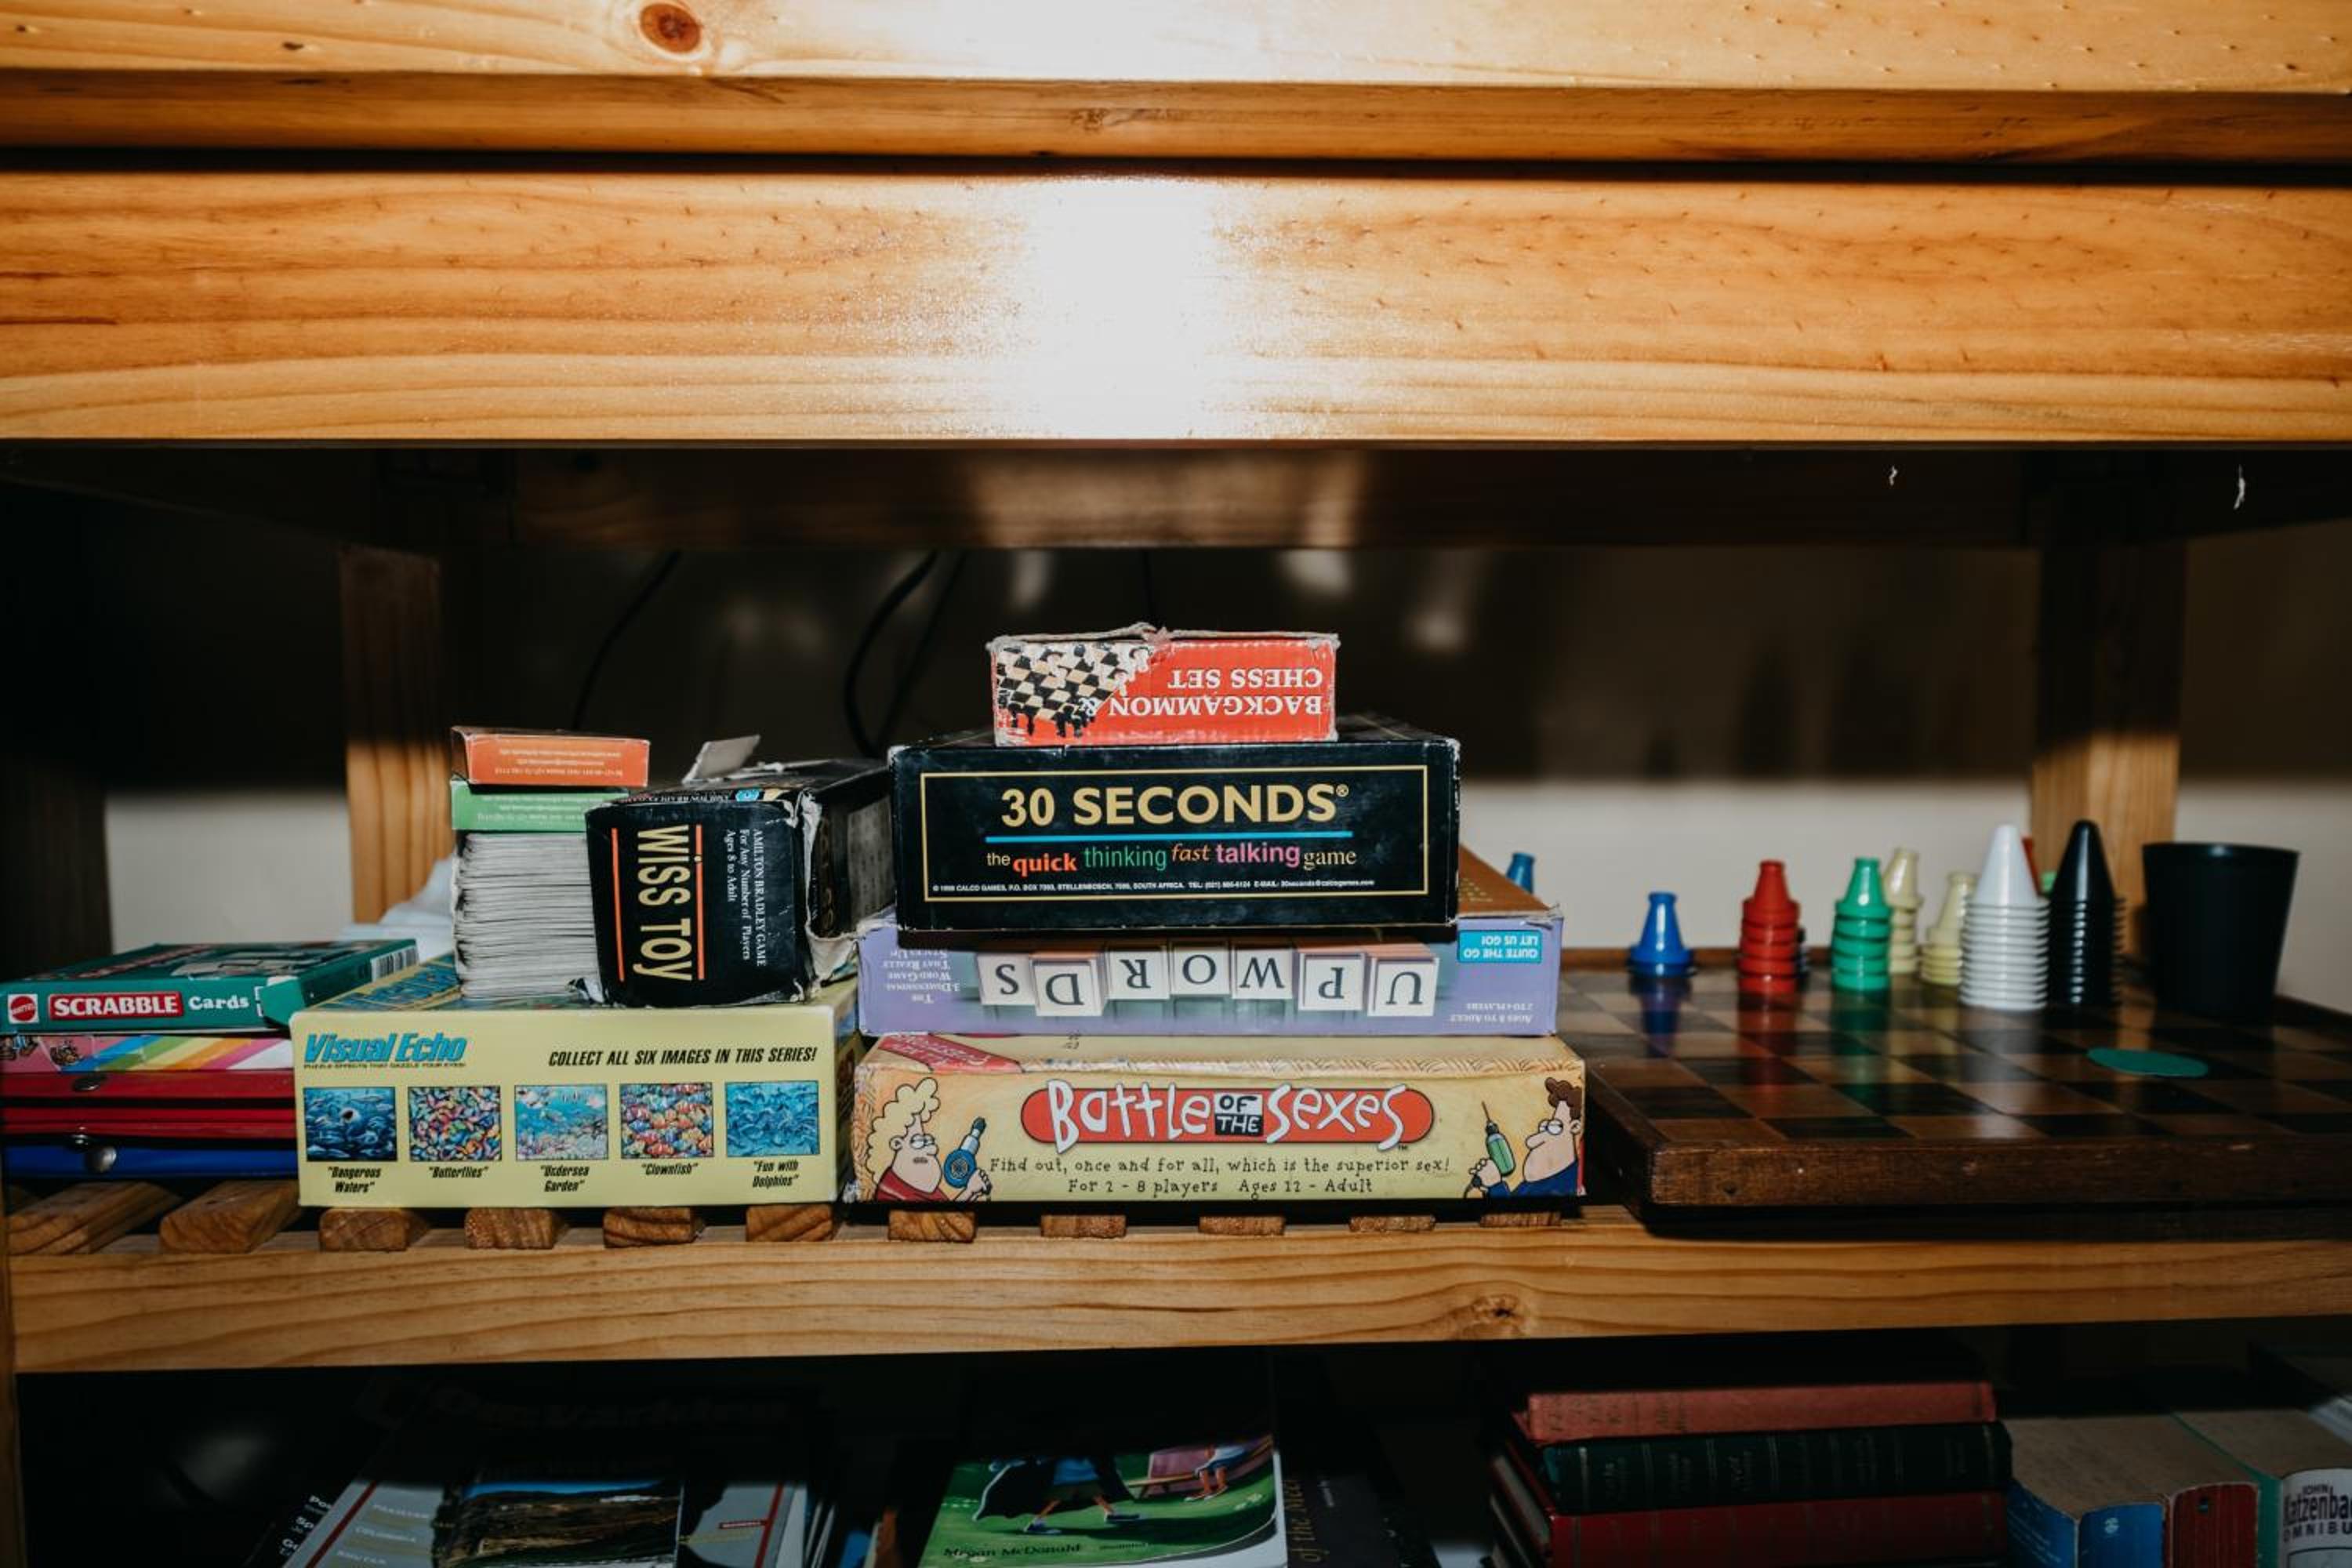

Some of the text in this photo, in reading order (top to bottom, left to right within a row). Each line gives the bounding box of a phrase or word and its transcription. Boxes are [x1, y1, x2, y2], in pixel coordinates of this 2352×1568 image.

[1167, 669, 1323, 688] CHESS SET
[1109, 695, 1323, 716] BACKGAMMON
[1000, 787, 1055, 828] 30
[724, 829, 736, 851] Ages
[727, 864, 737, 874] to
[985, 842, 1358, 877] the quick thinking fast talking game
[727, 876, 738, 902] Adult
[739, 829, 753, 960] For Any Number of Players
[753, 879, 766, 933] BRADLEY
[756, 934, 767, 967] GAME
[1481, 935, 1538, 946] LET US GO!
[1463, 947, 1538, 958] QUITE THE GO
[53, 994, 250, 1017] SCRABBLE Cards
[303, 1032, 468, 1063] Visual Echo
[549, 1047, 818, 1067] COLLECT ALL SIX IMAGES IN THIS SERIES!
[1219, 1094, 1261, 1110] OF
[1047, 1079, 1211, 1154] Battle
[1216, 1115, 1261, 1134] THE
[777, 1160, 799, 1171] with
[989, 1157, 1450, 1177] Find out, once and for all, which is the superior sex!
[1069, 1179, 1098, 1193] For
[1106, 1180, 1114, 1192] 2
[1137, 1180, 1146, 1192] 8
[1153, 1178, 1218, 1199] players
[1239, 1179, 1277, 1201] Ages
[1284, 1179, 1301, 1192] 12
[1324, 1178, 1374, 1193] Adult
[2303, 1483, 2329, 1496] JOHN
[2283, 1486, 2352, 1526] Katzenba
[943, 1544, 1082, 1559] Megan McDonald
